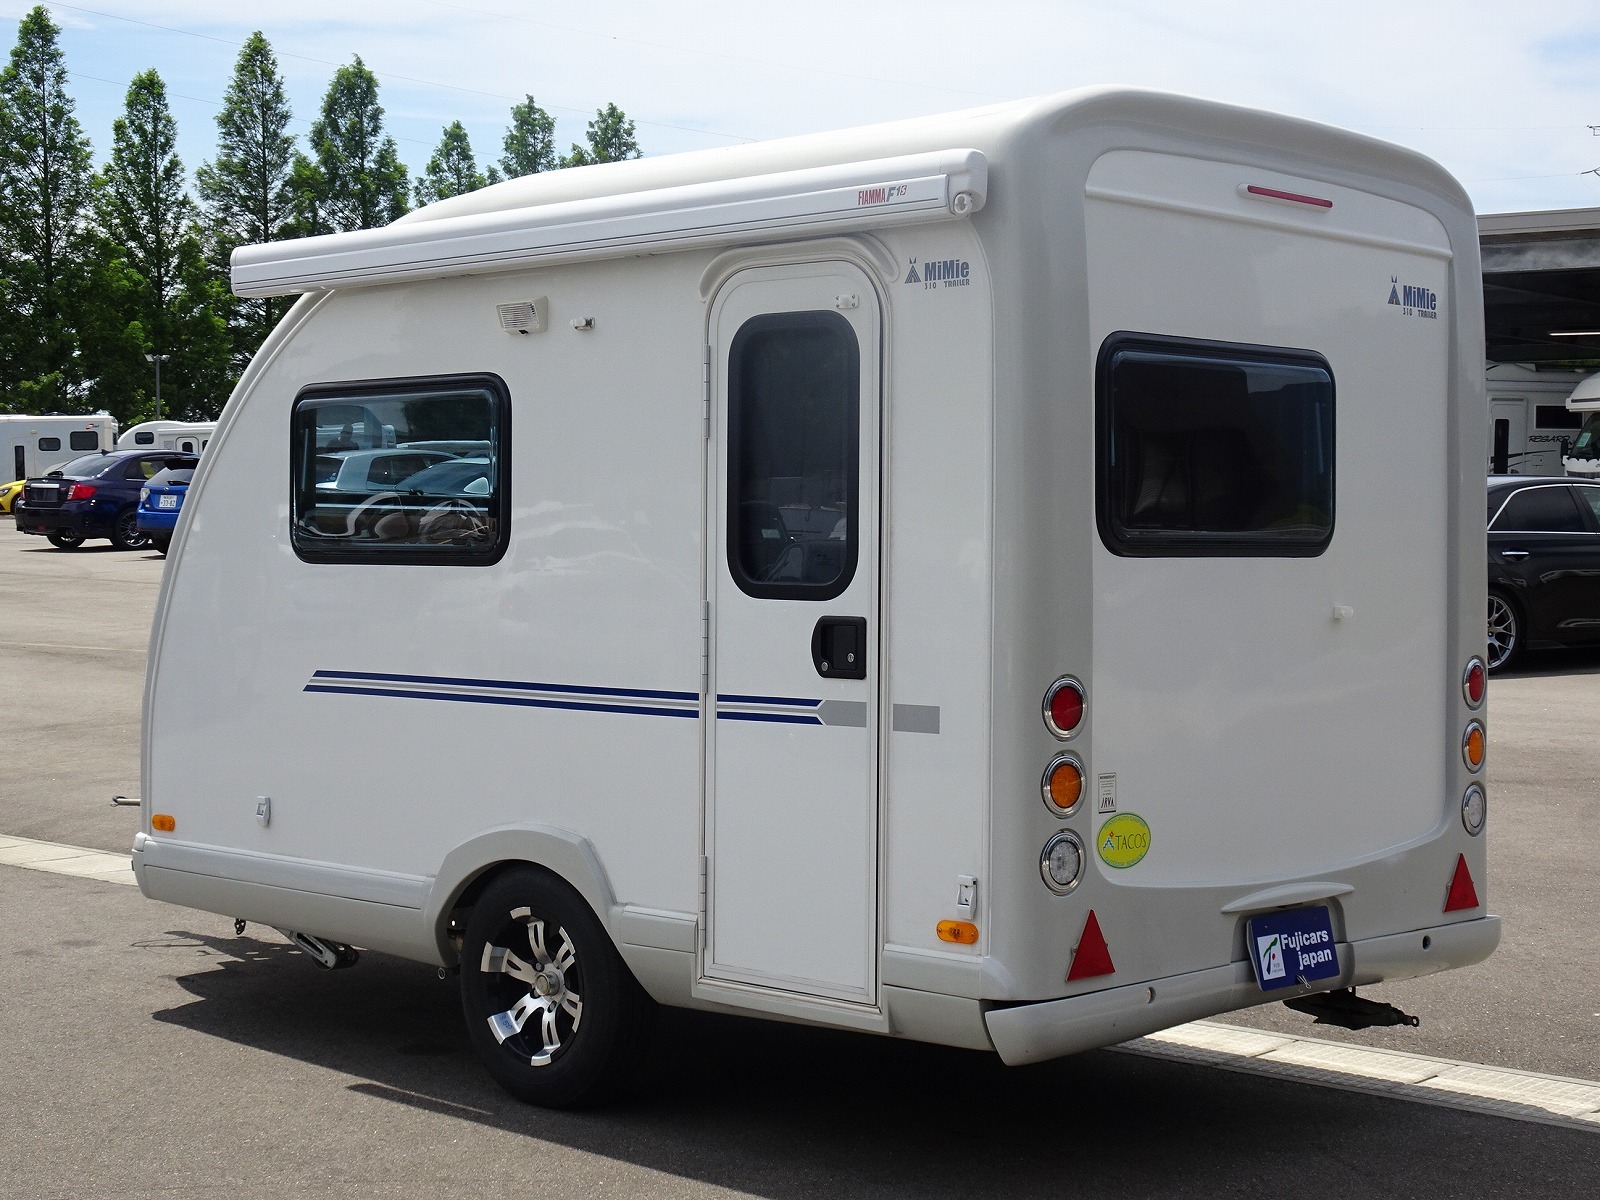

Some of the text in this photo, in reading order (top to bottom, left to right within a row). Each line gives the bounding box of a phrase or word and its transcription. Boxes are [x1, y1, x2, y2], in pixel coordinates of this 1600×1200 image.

[858, 188, 886, 205] FIAMMA
[924, 259, 970, 281] MiMie
[943, 278, 970, 288] TRAILER
[1402, 284, 1437, 310] MiMie
[1417, 309, 1438, 320] TRAILER
[1115, 832, 1147, 851] TACOS
[1280, 930, 1329, 951] Fujicars
[1298, 948, 1333, 971] japan
